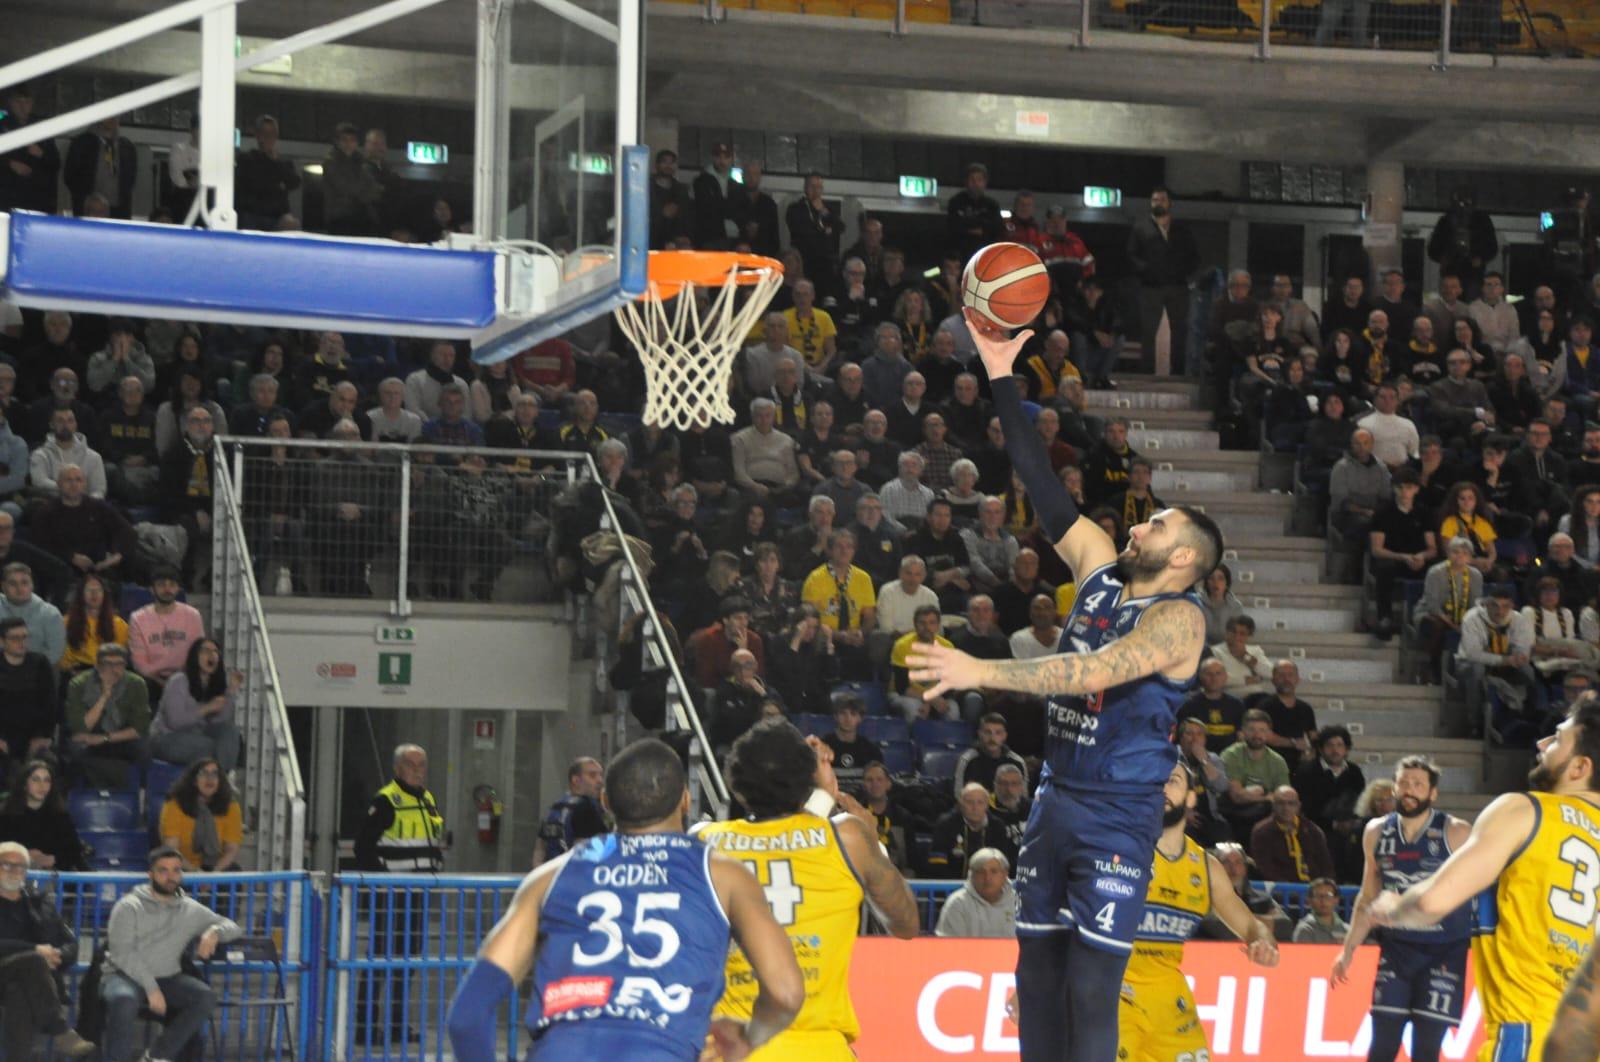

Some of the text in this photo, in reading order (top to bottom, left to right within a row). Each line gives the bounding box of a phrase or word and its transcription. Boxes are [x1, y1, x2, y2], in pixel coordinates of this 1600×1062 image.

[1083, 591, 1108, 613] 4
[704, 827, 828, 851] WIDEMAN
[593, 863, 669, 887] OGDEN
[1095, 859, 1142, 879] TULIPANO
[1548, 834, 1600, 928] 3
[572, 890, 681, 968] 35
[1095, 902, 1116, 932] 4
[1427, 990, 1452, 1014] 11
